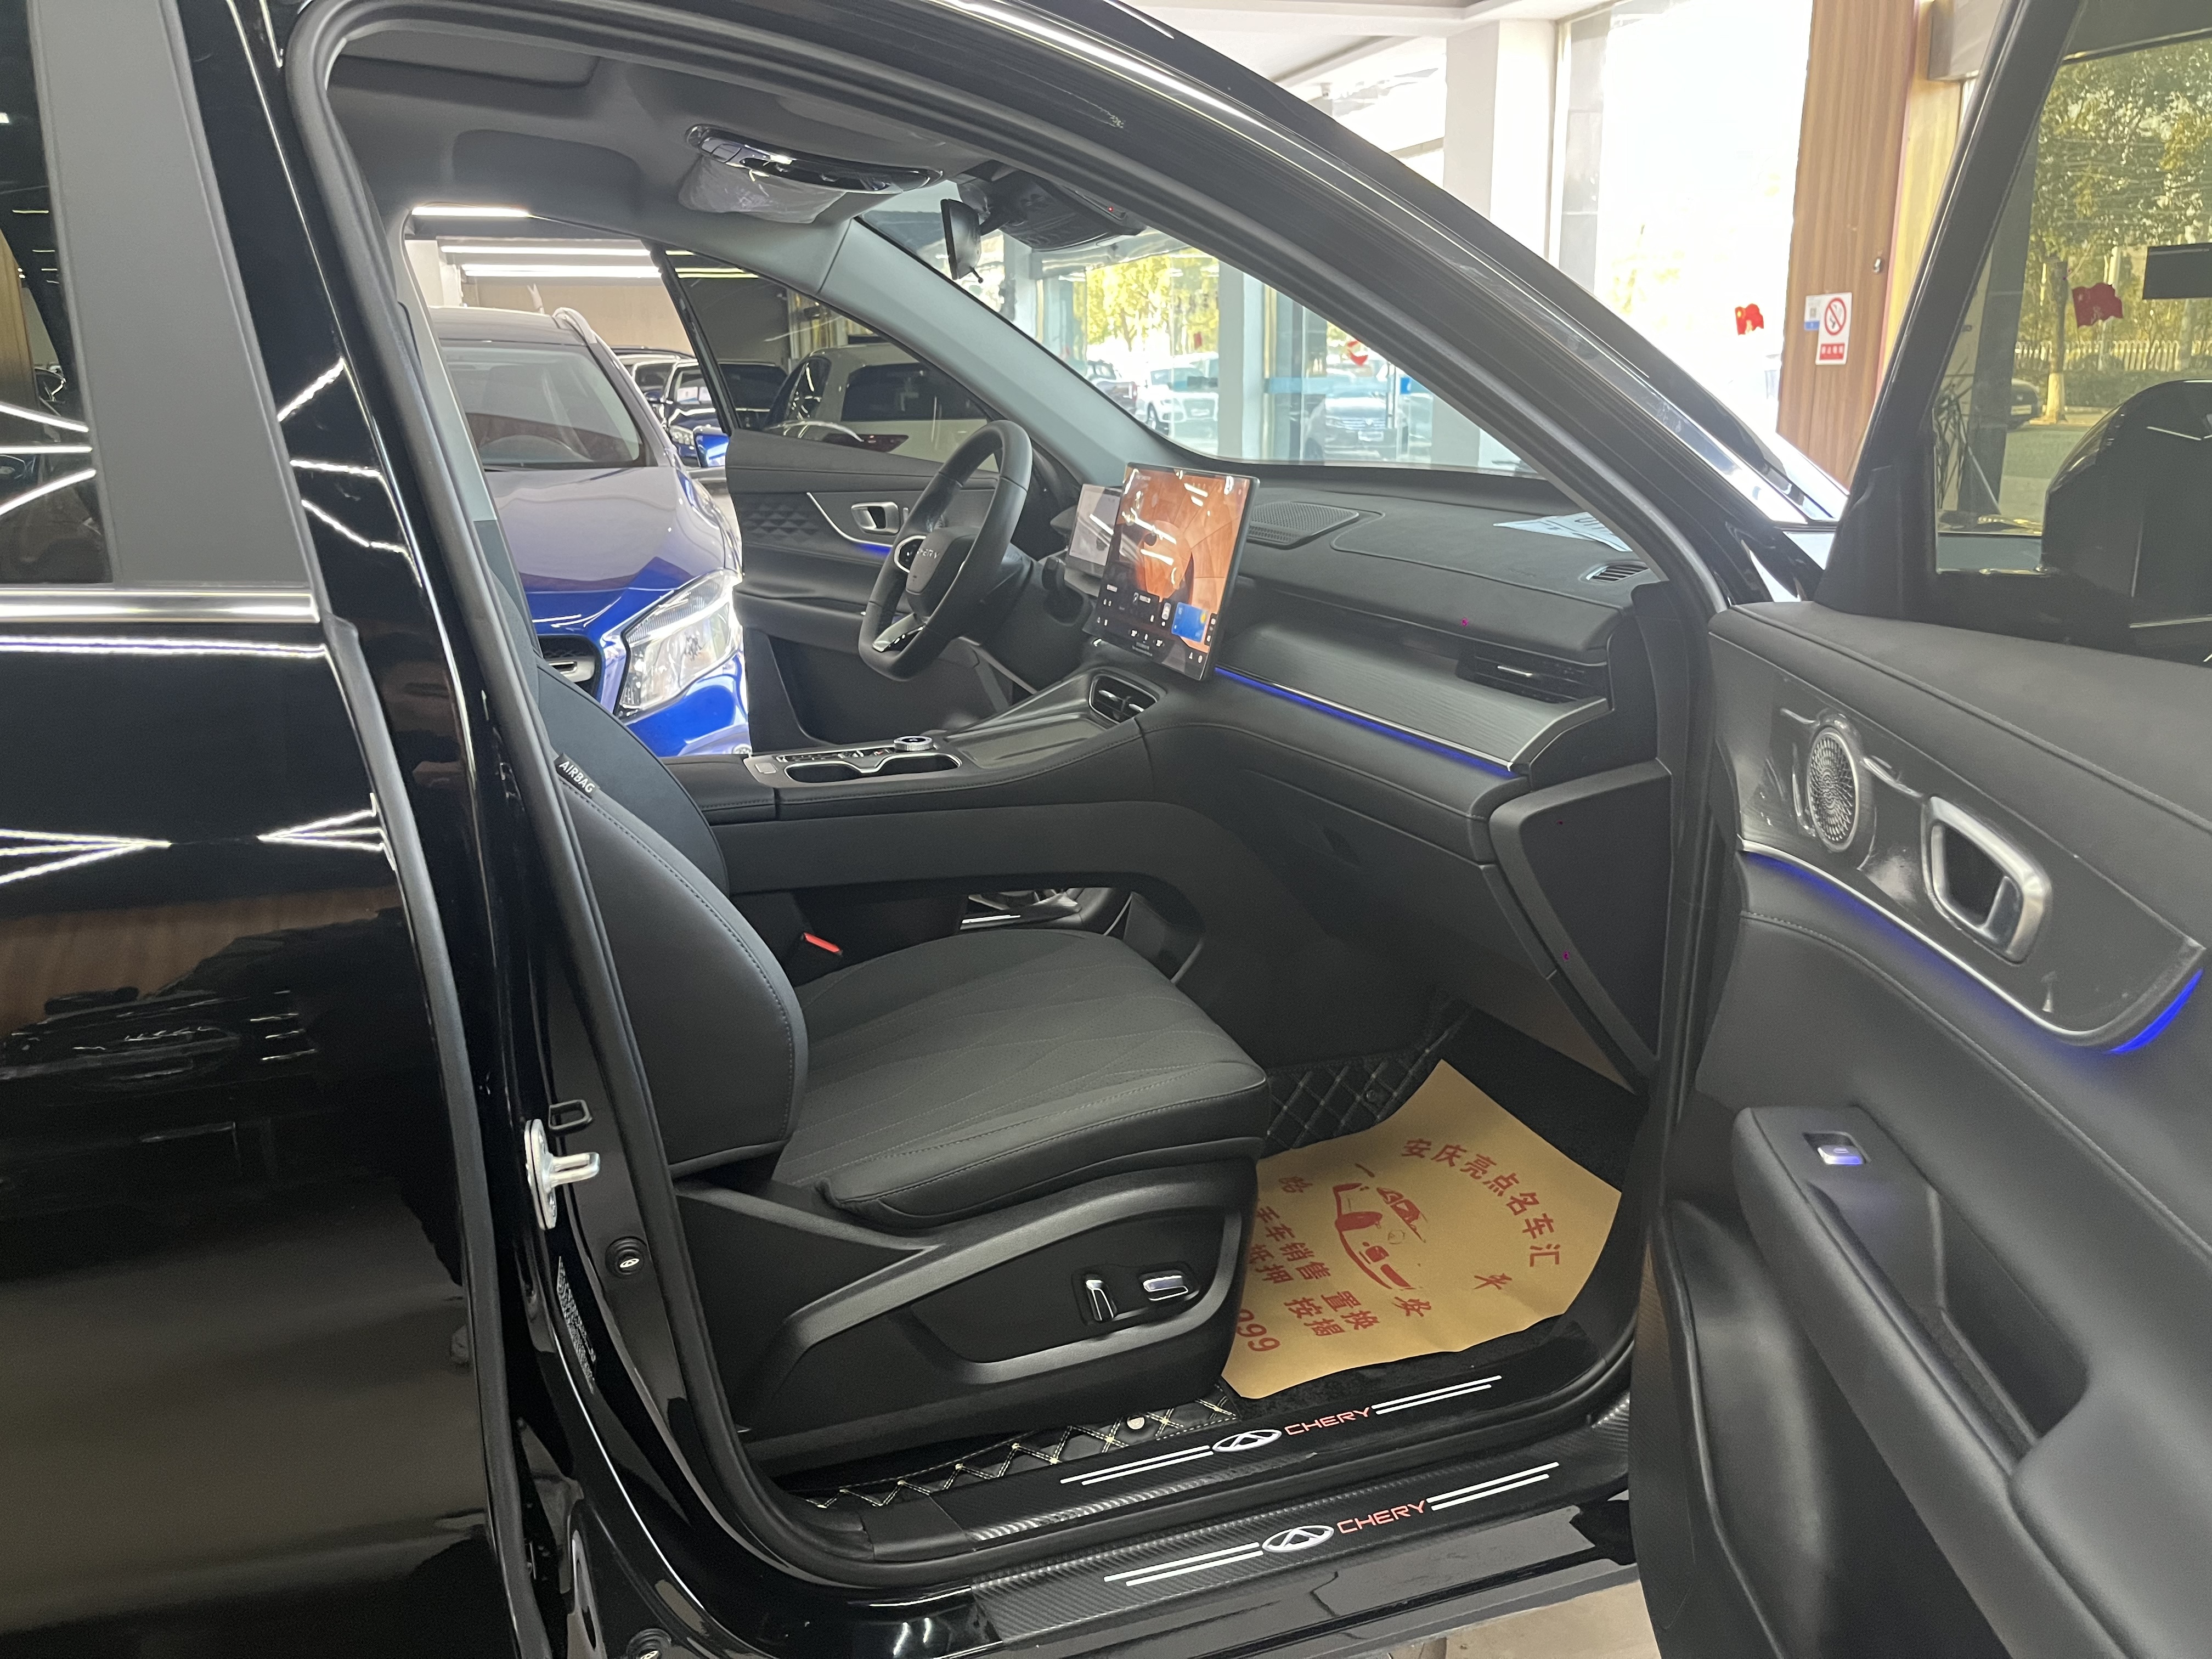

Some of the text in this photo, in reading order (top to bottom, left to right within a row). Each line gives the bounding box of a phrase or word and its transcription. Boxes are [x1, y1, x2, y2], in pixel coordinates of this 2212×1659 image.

[558, 760, 595, 793] AIRBAG
[1401, 1138, 1561, 1267] 安庆亮点名车汇
[1256, 1199, 1331, 1280] 手车销售
[1283, 1297, 1346, 1337] 按揭
[1284, 1407, 1370, 1436] CHERY
[1336, 1500, 1425, 1534] CHERY
